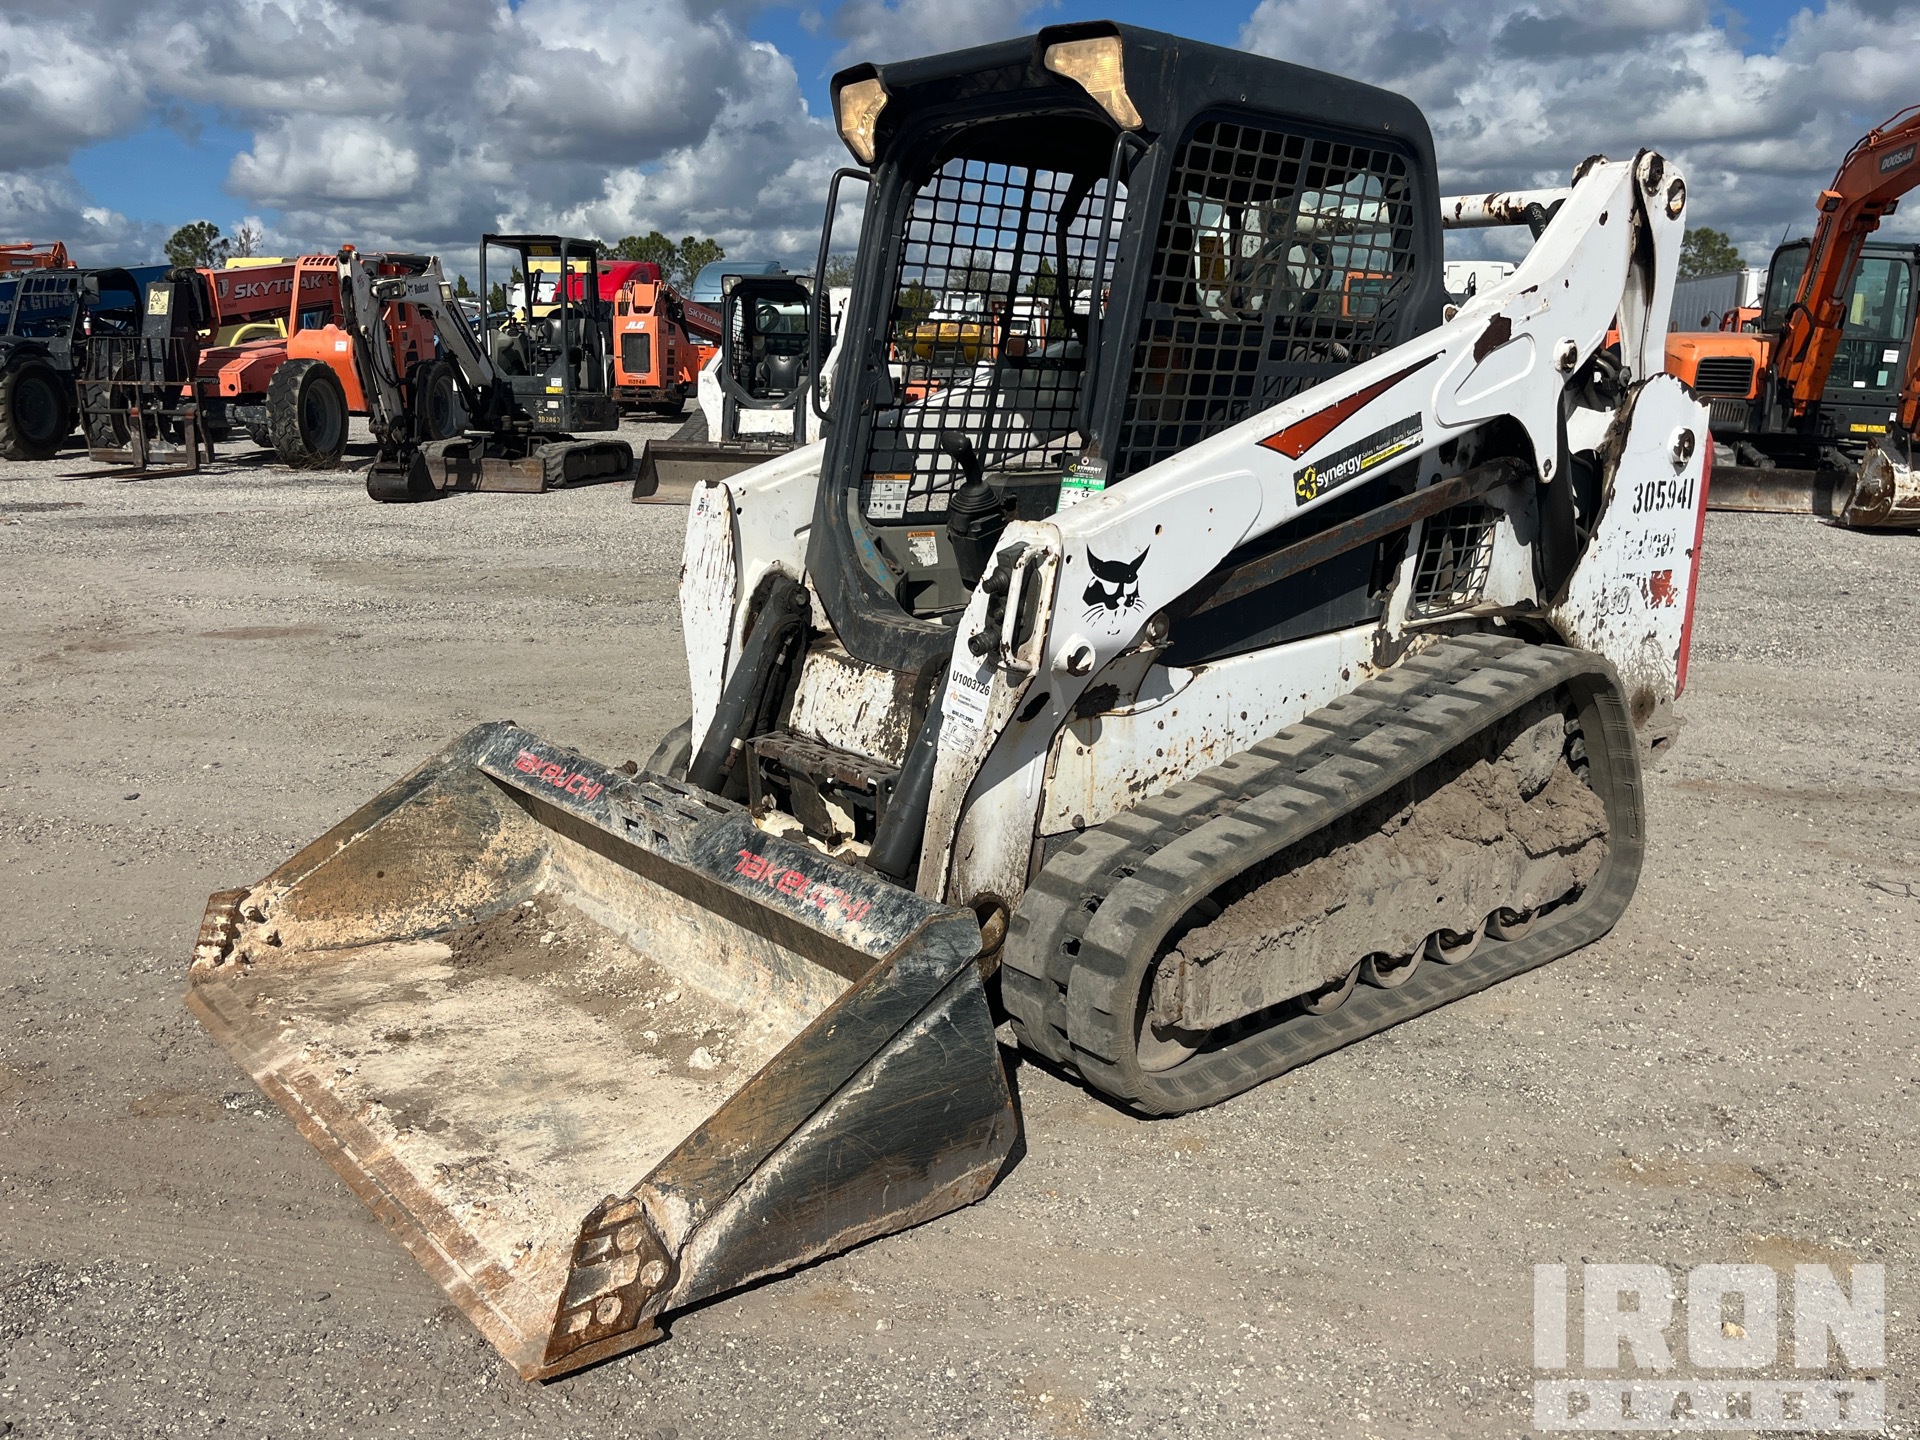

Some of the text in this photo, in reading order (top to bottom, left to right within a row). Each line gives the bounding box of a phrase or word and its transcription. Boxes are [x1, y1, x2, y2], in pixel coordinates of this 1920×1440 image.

[1880, 148, 1914, 170] DOOSAN
[234, 274, 324, 299] SKYTRAK
[414, 283, 429, 294] Bobcat
[625, 321, 645, 330] JLG
[688, 307, 722, 327] SKYTRAK
[1362, 449, 1374, 459] Sales
[1375, 439, 1391, 451] Rental
[1393, 433, 1405, 442] Parts
[1406, 425, 1422, 437] Service
[1316, 454, 1362, 488] synergy
[1632, 478, 1695, 514] 305941
[952, 670, 991, 696] U1003726
